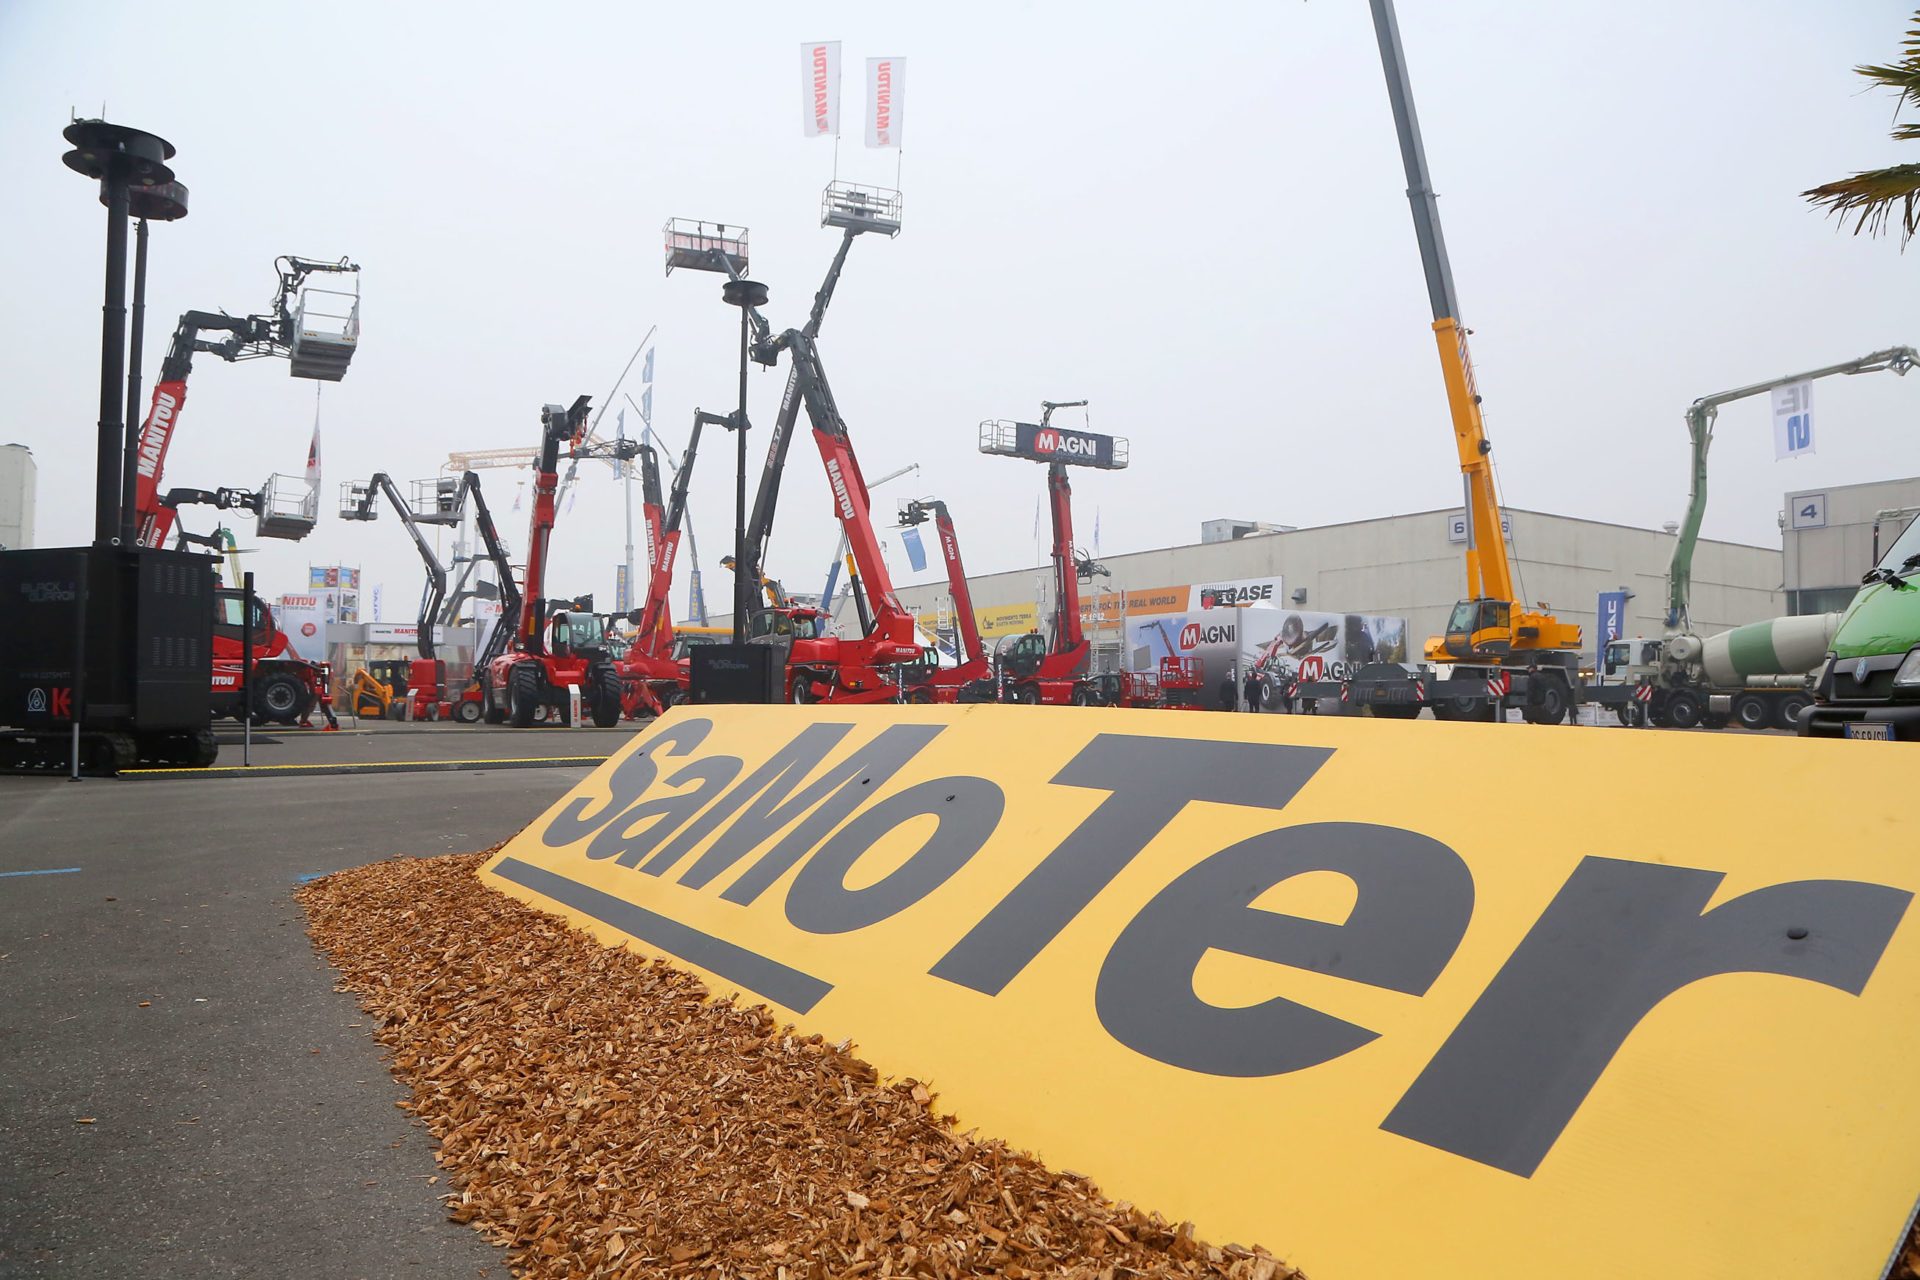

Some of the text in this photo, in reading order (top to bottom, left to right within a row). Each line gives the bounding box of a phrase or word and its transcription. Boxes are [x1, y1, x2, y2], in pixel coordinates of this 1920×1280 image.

[137, 392, 176, 479] MANITOU
[1038, 432, 1097, 456] MAGNI
[827, 458, 856, 520] MANITOU
[1800, 504, 1817, 519] 4
[1454, 522, 1464, 533] 6
[646, 519, 656, 565] MANITOU
[944, 536, 955, 560] MAGNI
[661, 541, 674, 572] MANITOU
[282, 596, 317, 606] NITOU
[1129, 598, 1148, 608] REAL
[1149, 596, 1177, 606] WORLD
[1183, 625, 1235, 646] MAGNI
[543, 719, 1914, 1177] SaMoTer
